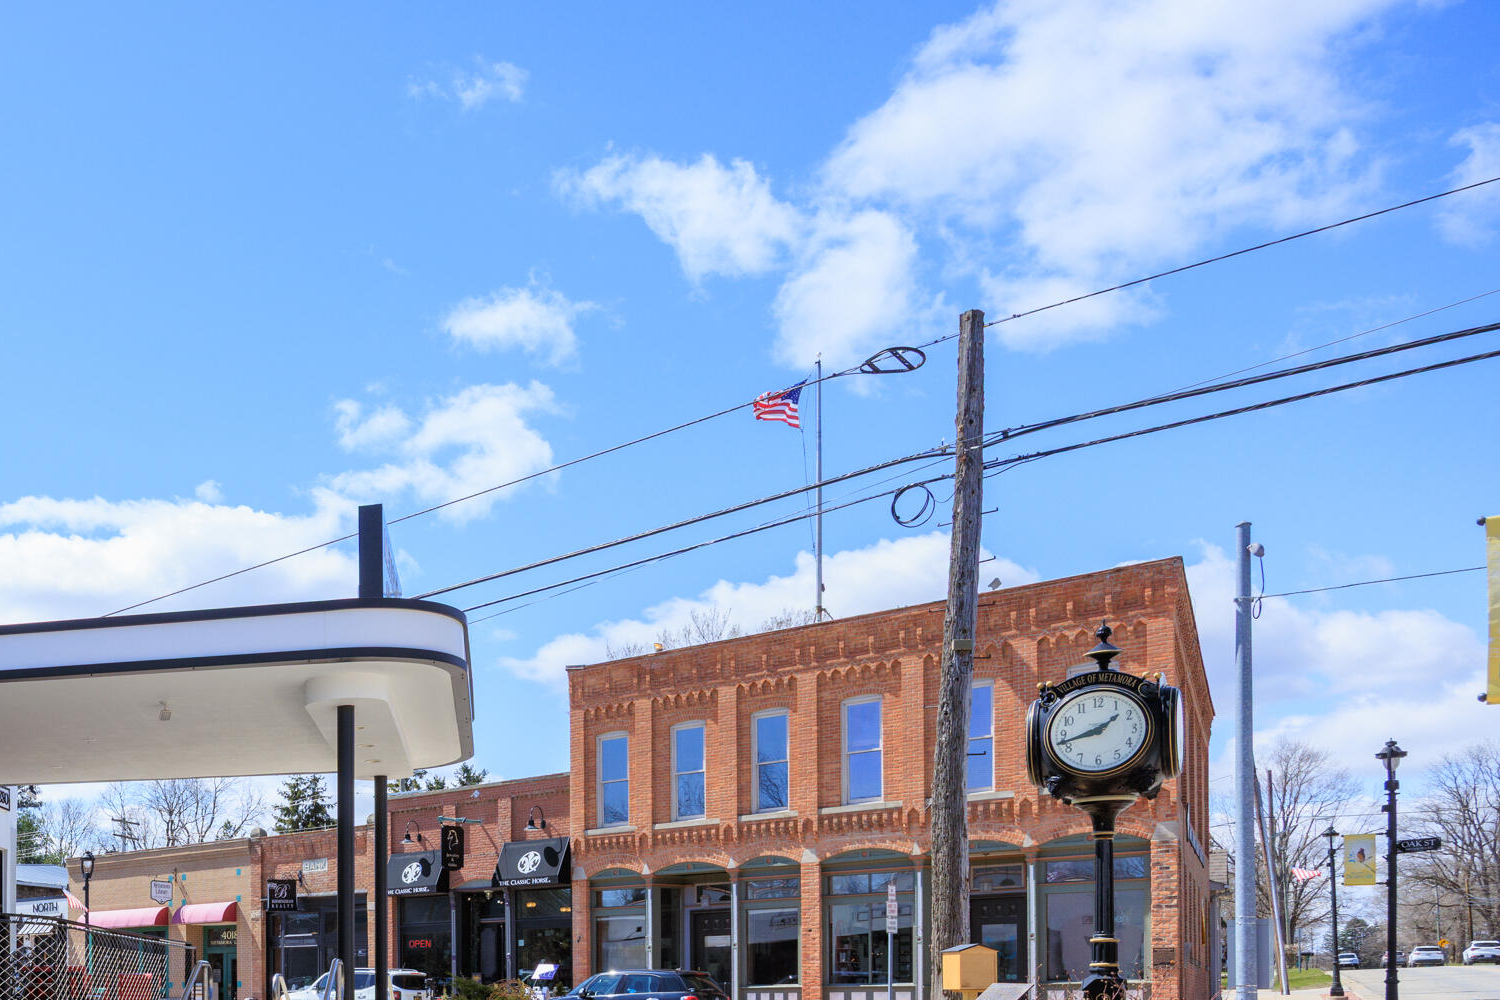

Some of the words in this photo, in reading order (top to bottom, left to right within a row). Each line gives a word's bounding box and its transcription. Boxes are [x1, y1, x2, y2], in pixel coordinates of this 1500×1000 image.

[1056, 675, 1086, 694] VILLAGE
[1087, 673, 1097, 683] OF
[1097, 671, 1138, 688] METAMORA
[1093, 697, 1104, 708] 12
[1113, 700, 1118, 710] 1
[1077, 703, 1086, 714] 11
[1125, 710, 1132, 720] 2
[1064, 716, 1074, 727] 10
[1131, 723, 1138, 734] 3
[1060, 729, 1067, 740] 9
[1125, 737, 1132, 748] 4
[1065, 743, 1072, 753] 8
[1076, 753, 1084, 763] 7
[1113, 750, 1120, 760] 5
[1095, 755, 1102, 766] 6
[1401, 840, 1423, 848] OAK
[1423, 839, 1436, 847] ST
[304, 861, 326, 871] BANK
[510, 878, 531, 886] CLASSIC
[395, 887, 413, 895] CLASSIC
[32, 901, 58, 913] NORTH
[408, 939, 432, 949] OPEN
